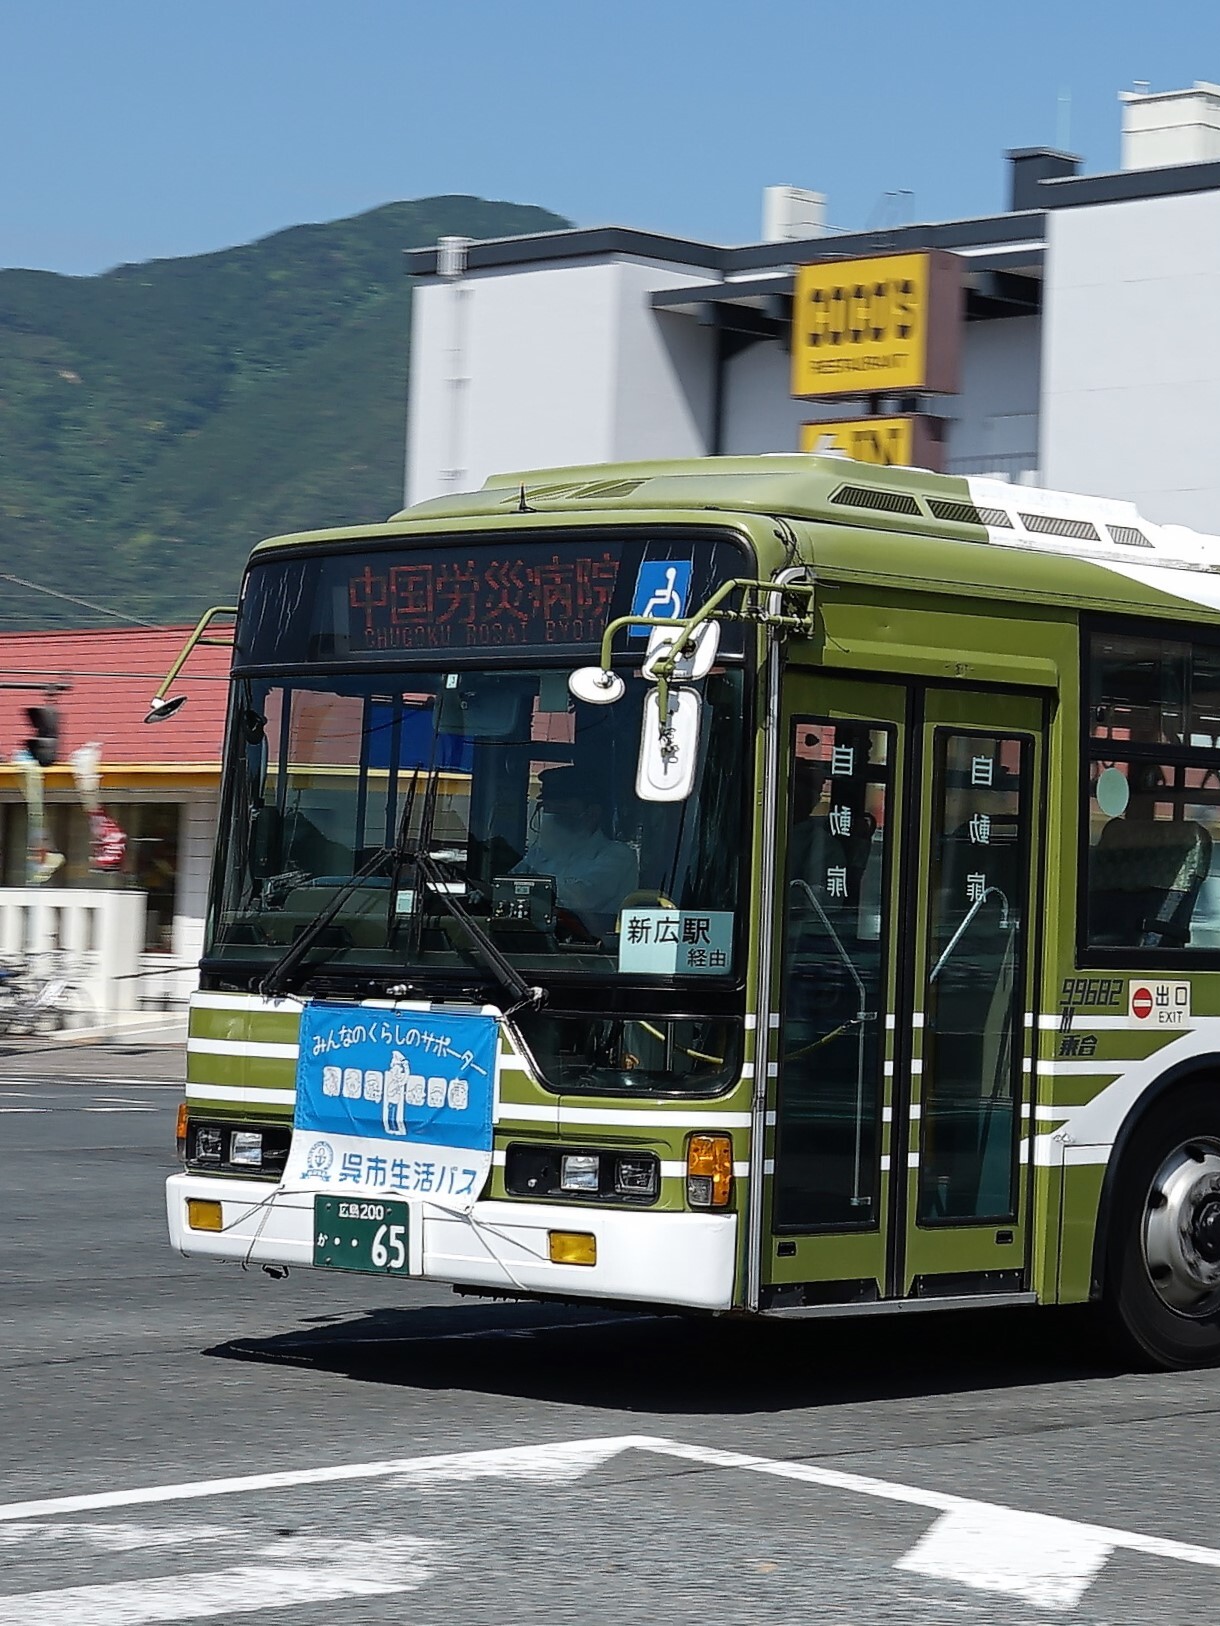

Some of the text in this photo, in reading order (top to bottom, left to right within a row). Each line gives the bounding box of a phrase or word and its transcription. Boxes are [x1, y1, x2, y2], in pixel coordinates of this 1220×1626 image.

[349, 552, 621, 628] 中国労災病院
[364, 622, 451, 648] CHUGOKU
[466, 619, 529, 646] ROSAI
[627, 916, 711, 945] 新広駅
[687, 947, 727, 968] 経由
[1155, 984, 1188, 1007] 出口
[1158, 1010, 1184, 1024] EXIT
[312, 1021, 489, 1077] みんなのくらしのサポーター
[1058, 1034, 1099, 1057] 乗合
[316, 1231, 329, 1247] か
